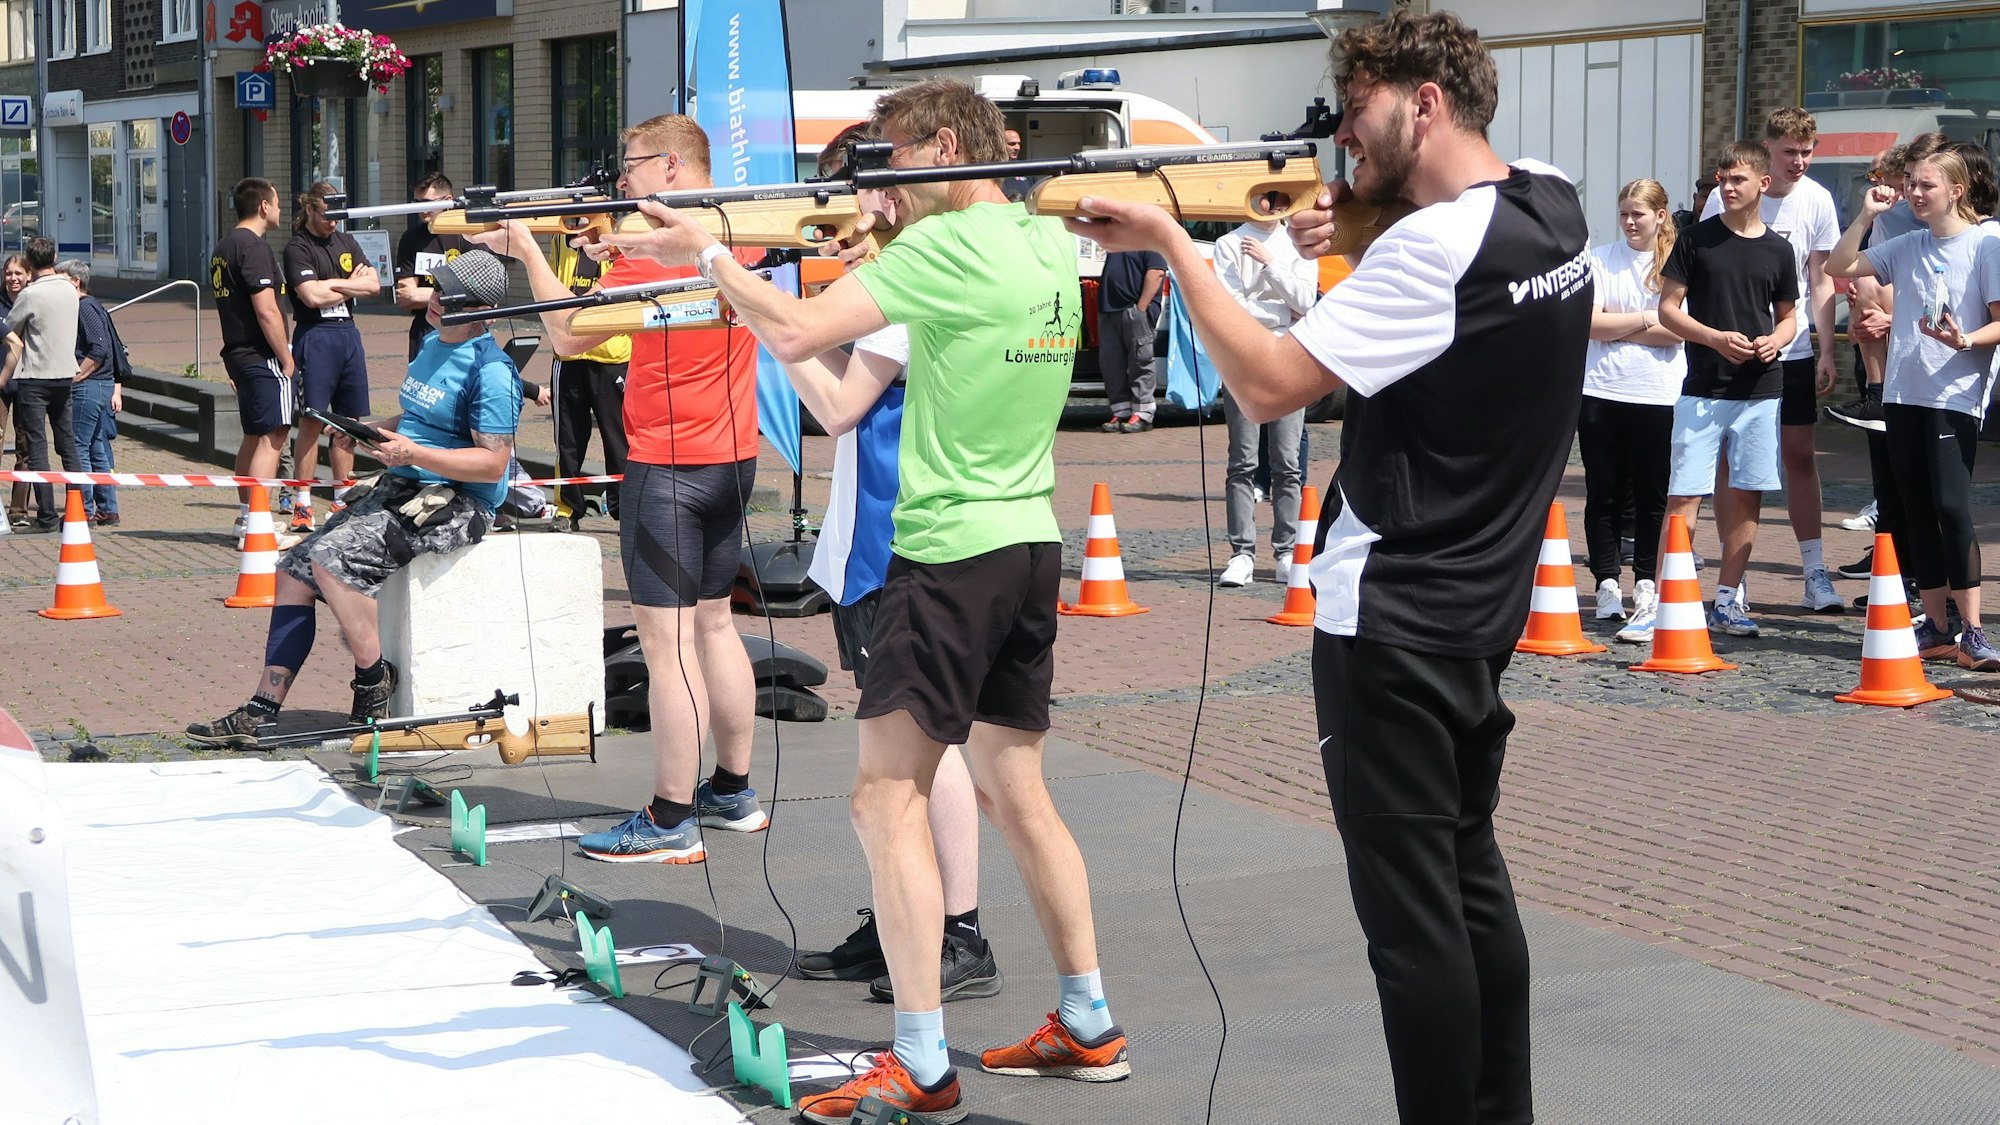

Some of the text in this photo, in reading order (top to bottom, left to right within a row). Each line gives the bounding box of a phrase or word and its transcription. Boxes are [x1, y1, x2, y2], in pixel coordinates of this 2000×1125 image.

[270, 0, 342, 35] Stern-Apothe
[248, 83, 262, 99] P
[684, 308, 713, 317] TOUR
[405, 375, 446, 401] BIATHLON
